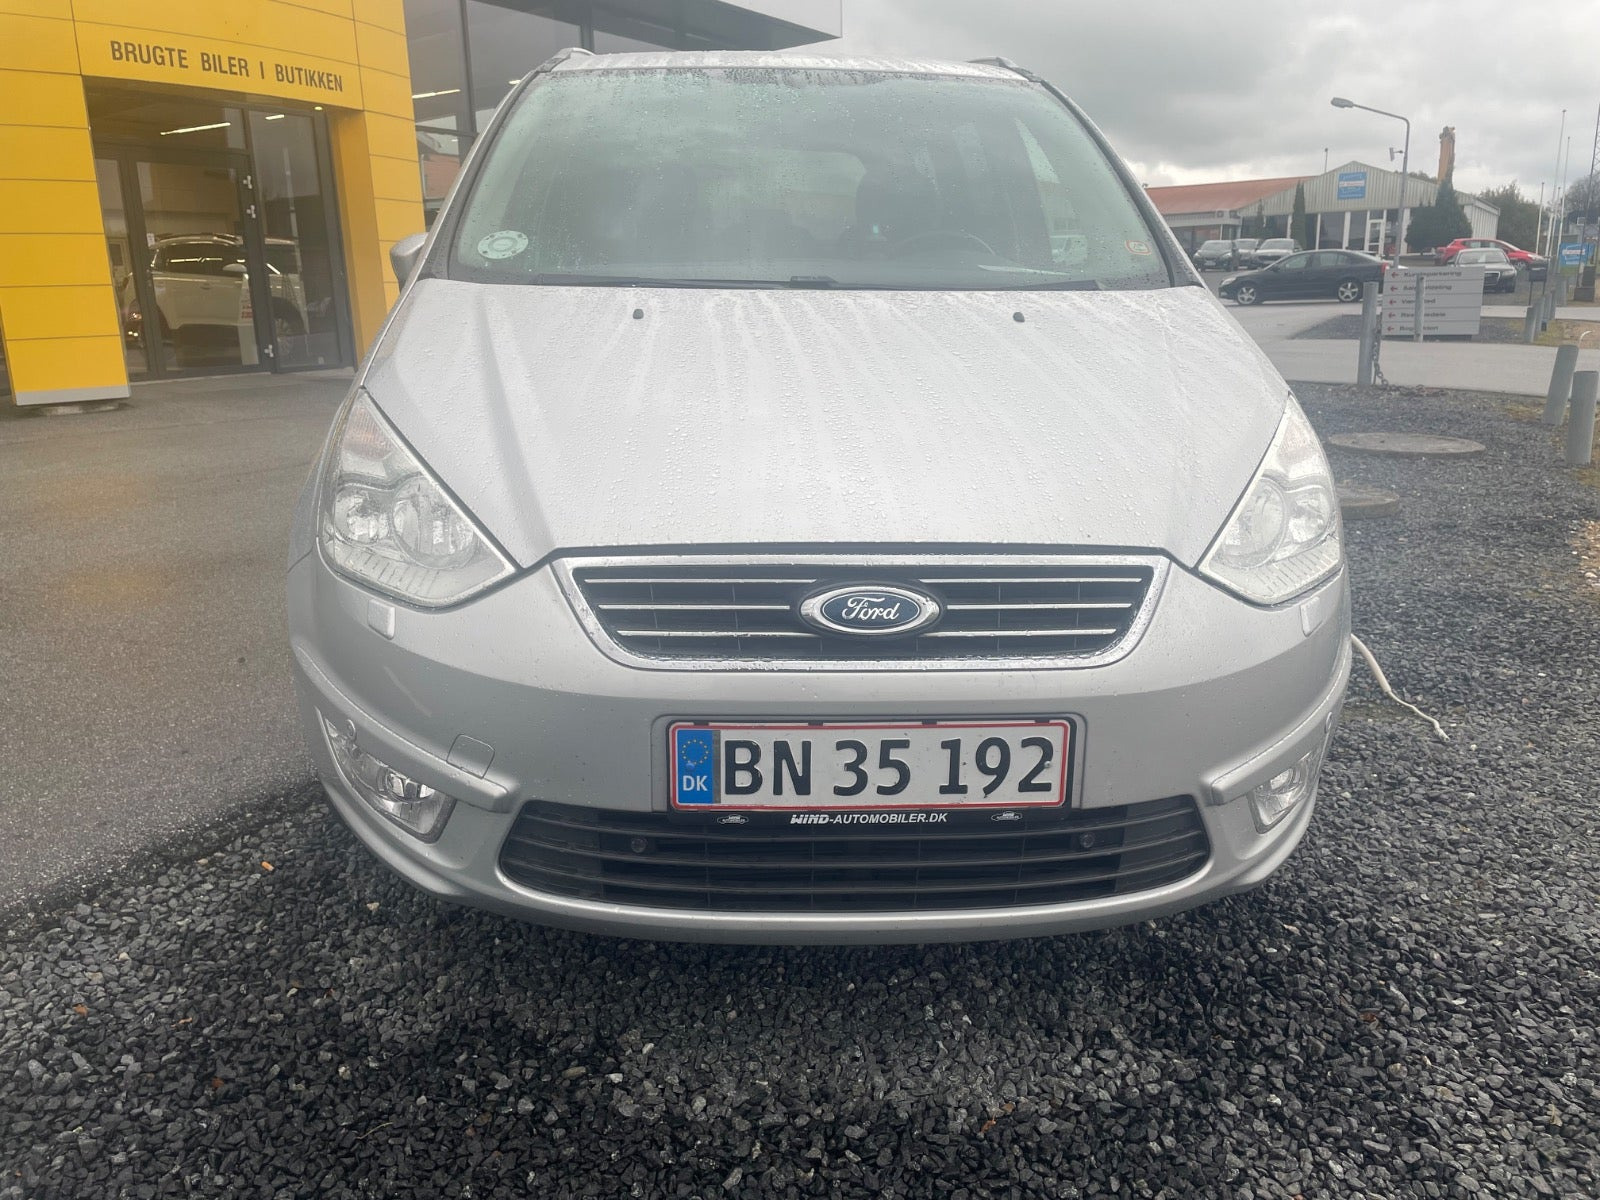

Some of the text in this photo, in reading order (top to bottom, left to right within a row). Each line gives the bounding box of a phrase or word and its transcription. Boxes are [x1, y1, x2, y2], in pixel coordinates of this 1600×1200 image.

[109, 40, 344, 92] BRUGTE BILER I BUTIKKEN
[841, 596, 901, 621] Ford
[682, 775, 708, 792] DK
[724, 736, 1054, 798] BN 35 192
